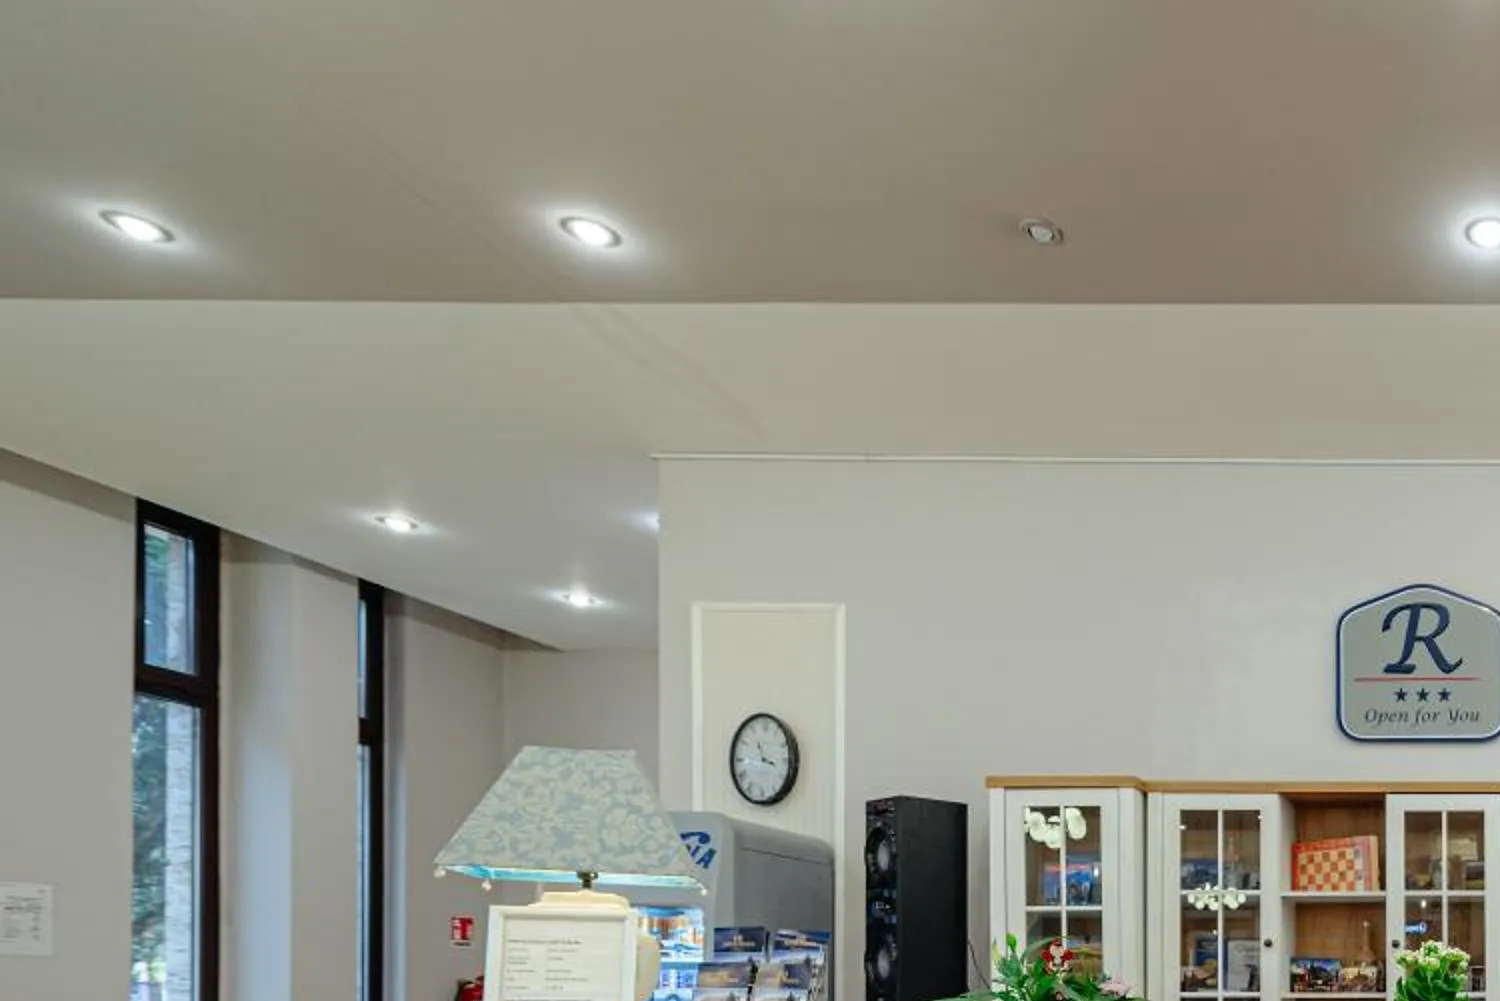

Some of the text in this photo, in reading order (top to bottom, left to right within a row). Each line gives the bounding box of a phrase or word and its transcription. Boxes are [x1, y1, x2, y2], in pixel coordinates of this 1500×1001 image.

[1381, 603, 1463, 674] R
[1364, 706, 1482, 727] Open for You
